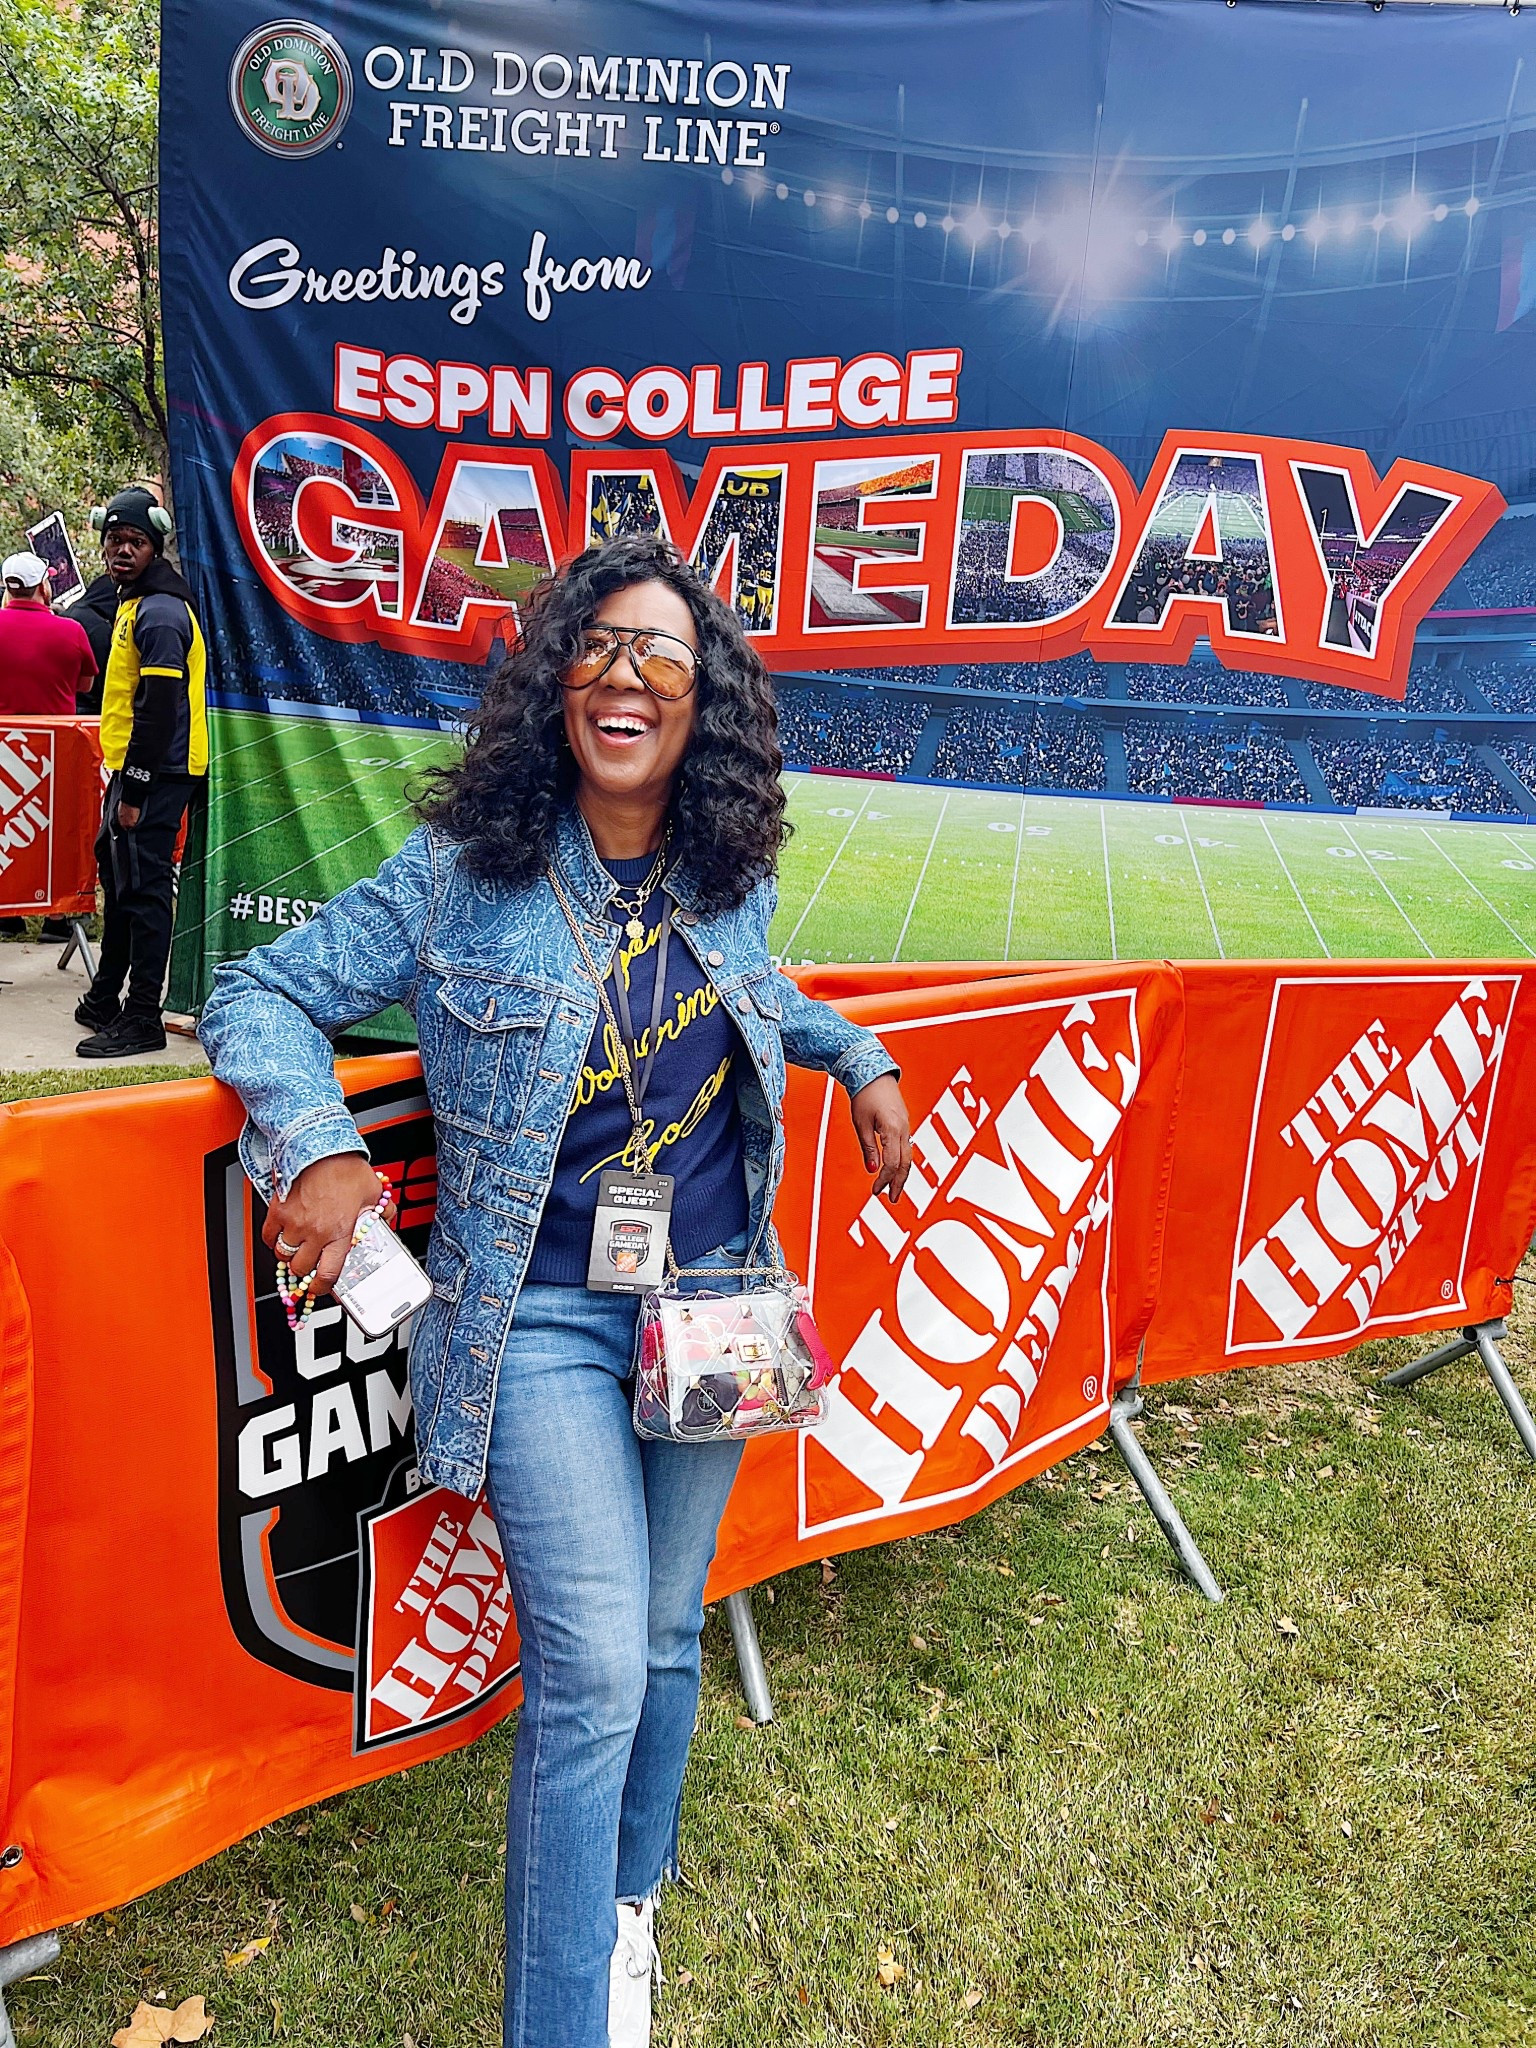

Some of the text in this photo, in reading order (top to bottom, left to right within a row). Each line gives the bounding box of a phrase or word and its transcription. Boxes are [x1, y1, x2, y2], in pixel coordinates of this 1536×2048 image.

[249, 38, 334, 76] OLD DOMINION
[363, 46, 791, 110] OLD DOMINION
[251, 107, 330, 141] FREIGHT LINE
[388, 102, 626, 159] FREIGHT
[229, 231, 652, 325] Greetings from
[336, 342, 961, 439] ESPN COLLEGE
[240, 425, 1480, 672] GAMEDAY
[1280, 1018, 1403, 1165] THE
[608, 1185, 663, 1199] SPECIAL
[613, 1195, 657, 1207] GUEST
[849, 1065, 991, 1264] THE
[1238, 980, 1504, 1341] HOME
[609, 1241, 649, 1250] GAMEDAY
[614, 1234, 645, 1243] COLLEGE
[804, 1000, 1140, 1508] HOME
[1342, 1101, 1483, 1327] DEPOT
[371, 1495, 505, 1724] HOM
[393, 1510, 464, 1617] THE
